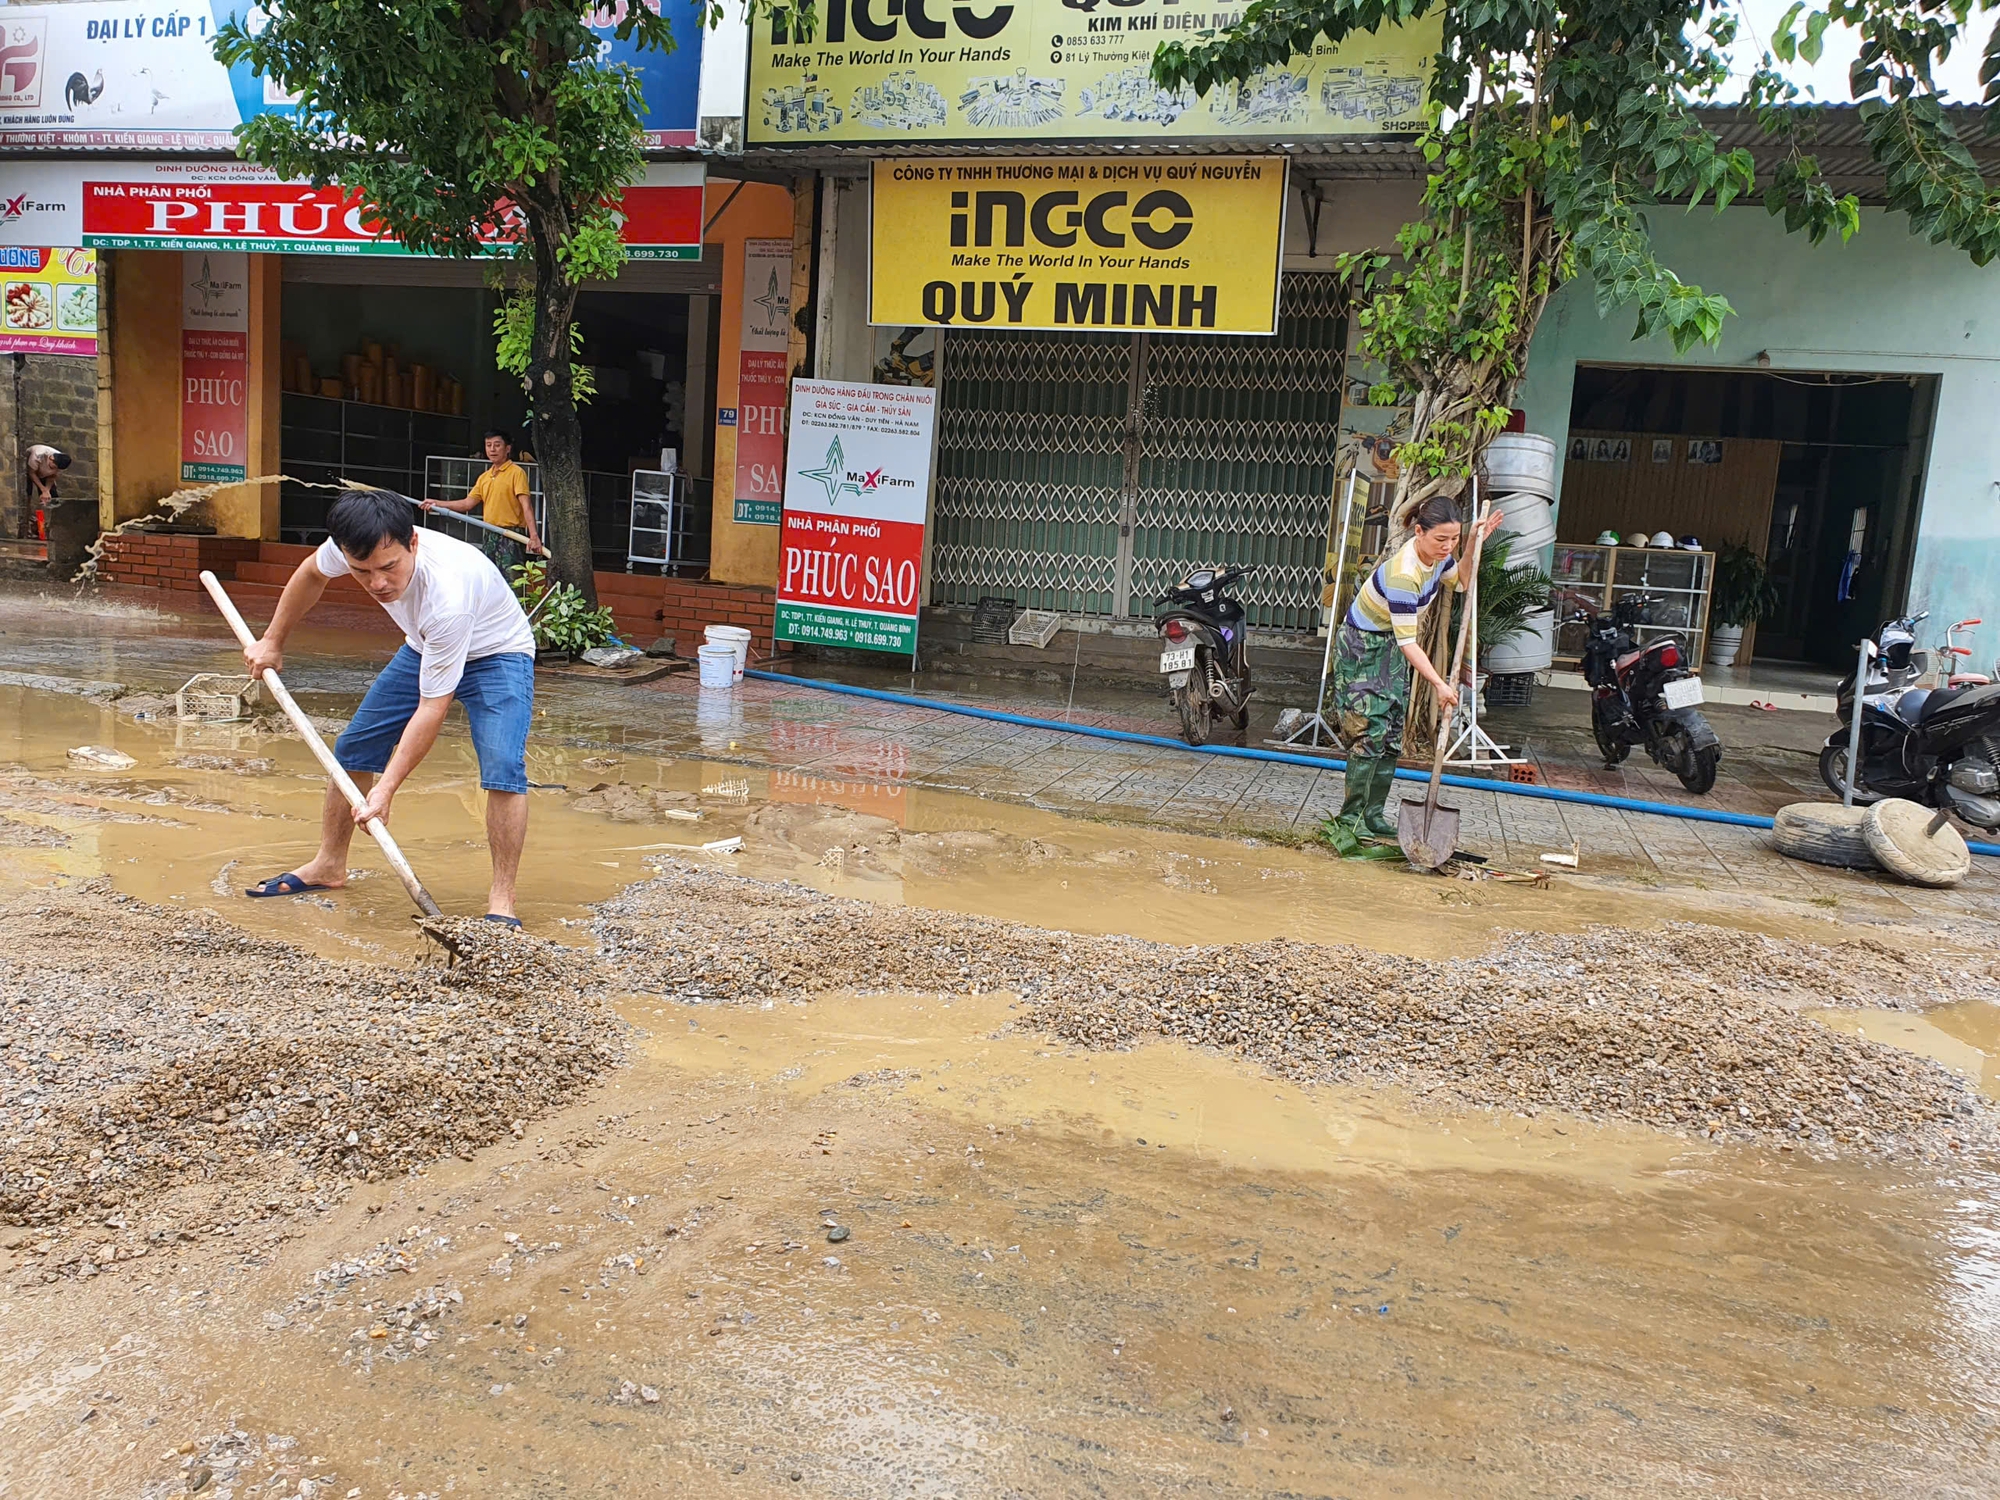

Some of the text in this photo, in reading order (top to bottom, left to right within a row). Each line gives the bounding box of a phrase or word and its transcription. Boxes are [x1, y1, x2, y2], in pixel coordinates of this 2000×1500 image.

[86, 8, 206, 43] ĐẠI LÝ CẤP 1
[1087, 8, 1246, 32] KIM KHÍ ĐIỆN MÁ
[1066, 34, 1125, 46] 0853 633 777
[771, 46, 1011, 68] Make The World In Your Hands
[1065, 52, 1076, 62] 81
[1078, 52, 1090, 64] Lý
[1093, 51, 1129, 63] Thường
[1131, 50, 1150, 62] Kiệt
[1381, 120, 1415, 131] SHOP
[37, 131, 56, 144] KIỆT
[62, 131, 87, 143] KHÓM
[136, 134, 163, 144] GIANG
[155, 165, 182, 173] DINH
[231, 164, 266, 173] HÀNG
[893, 159, 1261, 183] CÔNG TY TNHH THƯƠNG MẠI & DỊCH VỤ QUÝ NGUYỄN
[93, 183, 211, 198] NHÀ PHÂN PHỐI
[160, 238, 183, 248] KIẾN
[185, 241, 220, 250] GIANG,
[222, 241, 233, 250] H.
[235, 241, 247, 251] LỆ
[282, 243, 291, 251] T.
[293, 241, 332, 252] QUẢNG
[951, 253, 1190, 269] Make The World In Your Hands
[921, 272, 1218, 328] QUÝ MINH
[185, 370, 242, 406] PHÚC
[795, 384, 811, 393] DINH
[836, 385, 856, 398] HÀNG
[872, 390, 894, 401] TRONG
[915, 394, 933, 405] NUÔI
[722, 409, 735, 418] 79
[815, 400, 827, 409] GIA
[828, 399, 841, 411] SÚC
[846, 403, 859, 412] GIA
[193, 429, 233, 458] SAO
[787, 516, 881, 538] NHÀ PHÂN PHỐI
[783, 536, 916, 607] PHÚC SAO
[801, 624, 848, 642] 0914.749.963
[854, 631, 902, 648] 0918.699.730
